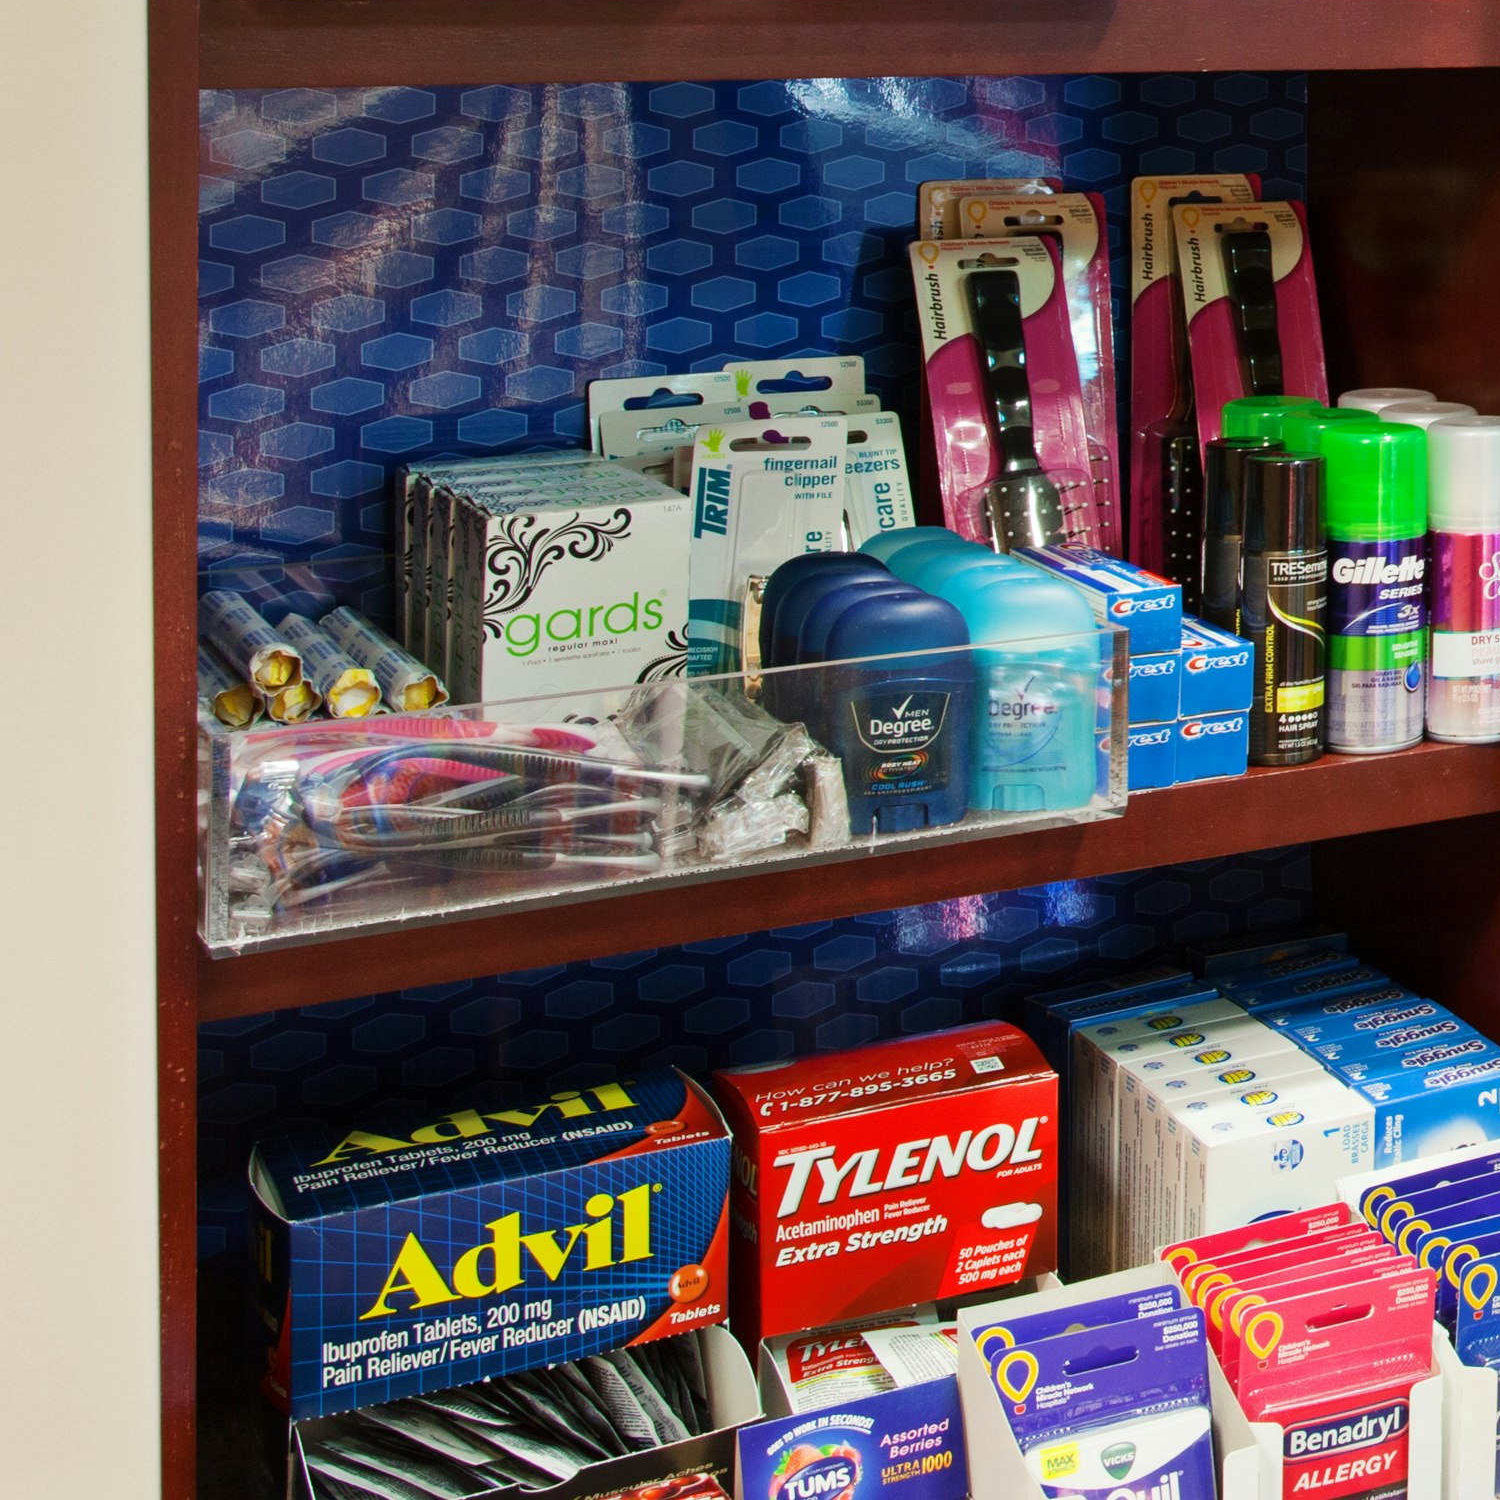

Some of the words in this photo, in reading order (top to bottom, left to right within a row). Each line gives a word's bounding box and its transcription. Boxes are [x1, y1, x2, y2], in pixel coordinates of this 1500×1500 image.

[1141, 213, 1153, 280] Hairbrush
[925, 273, 947, 340] Hairbrush
[764, 457, 837, 473] fingernail
[784, 474, 837, 488] clipper
[694, 467, 731, 539] TRIM
[794, 492, 815, 500] WITH
[817, 491, 832, 499] FILE
[1332, 555, 1425, 585] Gillette
[1112, 594, 1175, 616] Crest
[1379, 584, 1423, 600] SERIES
[504, 592, 663, 657] gards
[548, 641, 588, 653] regular
[593, 637, 618, 648] maxi
[1471, 634, 1492, 646] DRY
[1187, 652, 1248, 672] Crest
[870, 716, 931, 736] Degree
[906, 708, 930, 717] MEN
[1278, 722, 1296, 732] HAIR
[1298, 721, 1318, 732] SPRAY
[755, 1088, 805, 1103] How
[812, 1079, 851, 1090] can
[859, 1071, 890, 1082] we
[898, 1058, 954, 1075] help?
[780, 1069, 957, 1112] 1-877-895-3665
[309, 1081, 640, 1168] Advil
[1341, 1124, 1352, 1151] LOAD
[1361, 1120, 1370, 1152] CARGA
[1351, 1122, 1362, 1165] BRASSEE
[773, 1117, 1042, 1219] TYLENOL
[997, 1169, 1012, 1178] FOR
[1013, 1163, 1042, 1175] ADULTS
[775, 1207, 880, 1242] Acetaminophen
[359, 1182, 654, 1321] Advil
[775, 1239, 839, 1267] Extra
[845, 1215, 948, 1252] Strength
[959, 1247, 972, 1260] 50
[974, 1238, 1014, 1256] Pouches
[1016, 1234, 1029, 1246] of
[670, 1303, 721, 1324] Tablets
[322, 1332, 409, 1364] Ibuprofen
[413, 1316, 481, 1344] Tablets,
[486, 1305, 520, 1326] 200
[524, 1301, 552, 1324] mg
[1163, 1321, 1198, 1335] $250,000
[1163, 1330, 1198, 1343] Donation
[322, 1365, 363, 1388] Pain
[367, 1336, 499, 1382] Reliever/Fever
[502, 1319, 574, 1349] Reducer
[578, 1296, 646, 1335] (NSAID)
[880, 1419, 949, 1448] Assorted
[1290, 1406, 1400, 1454] Benadryl
[889, 1435, 942, 1459] Berries
[1103, 1452, 1134, 1467] VICKS
[881, 1462, 920, 1478] ULTRA
[922, 1451, 953, 1474] 1000
[1047, 1454, 1074, 1470] MAX
[1293, 1450, 1397, 1492] ALLERGY
[783, 1467, 849, 1496] TUMS
